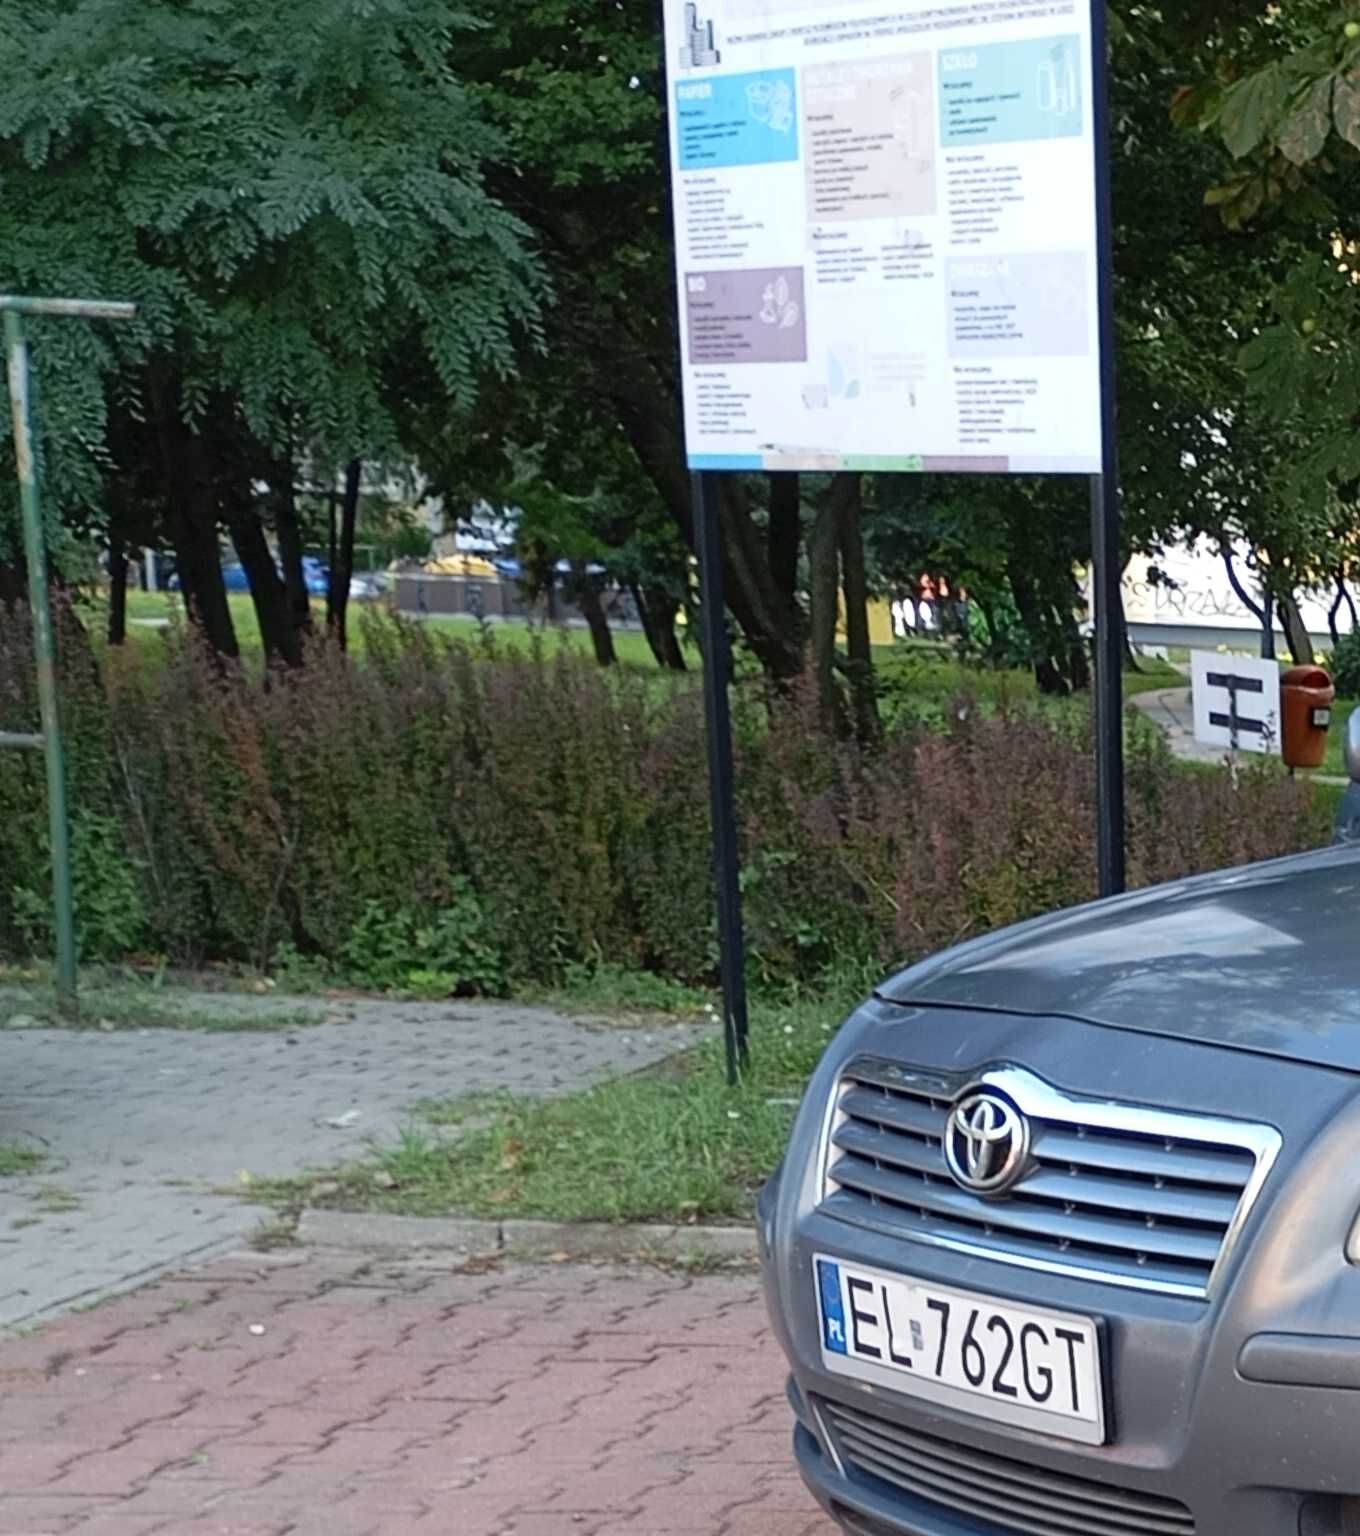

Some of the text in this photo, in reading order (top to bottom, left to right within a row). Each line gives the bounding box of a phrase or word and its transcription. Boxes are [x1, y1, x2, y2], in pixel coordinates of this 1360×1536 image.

[827, 1318, 845, 1342] PL
[847, 1275, 1085, 1412] EL 762GT
